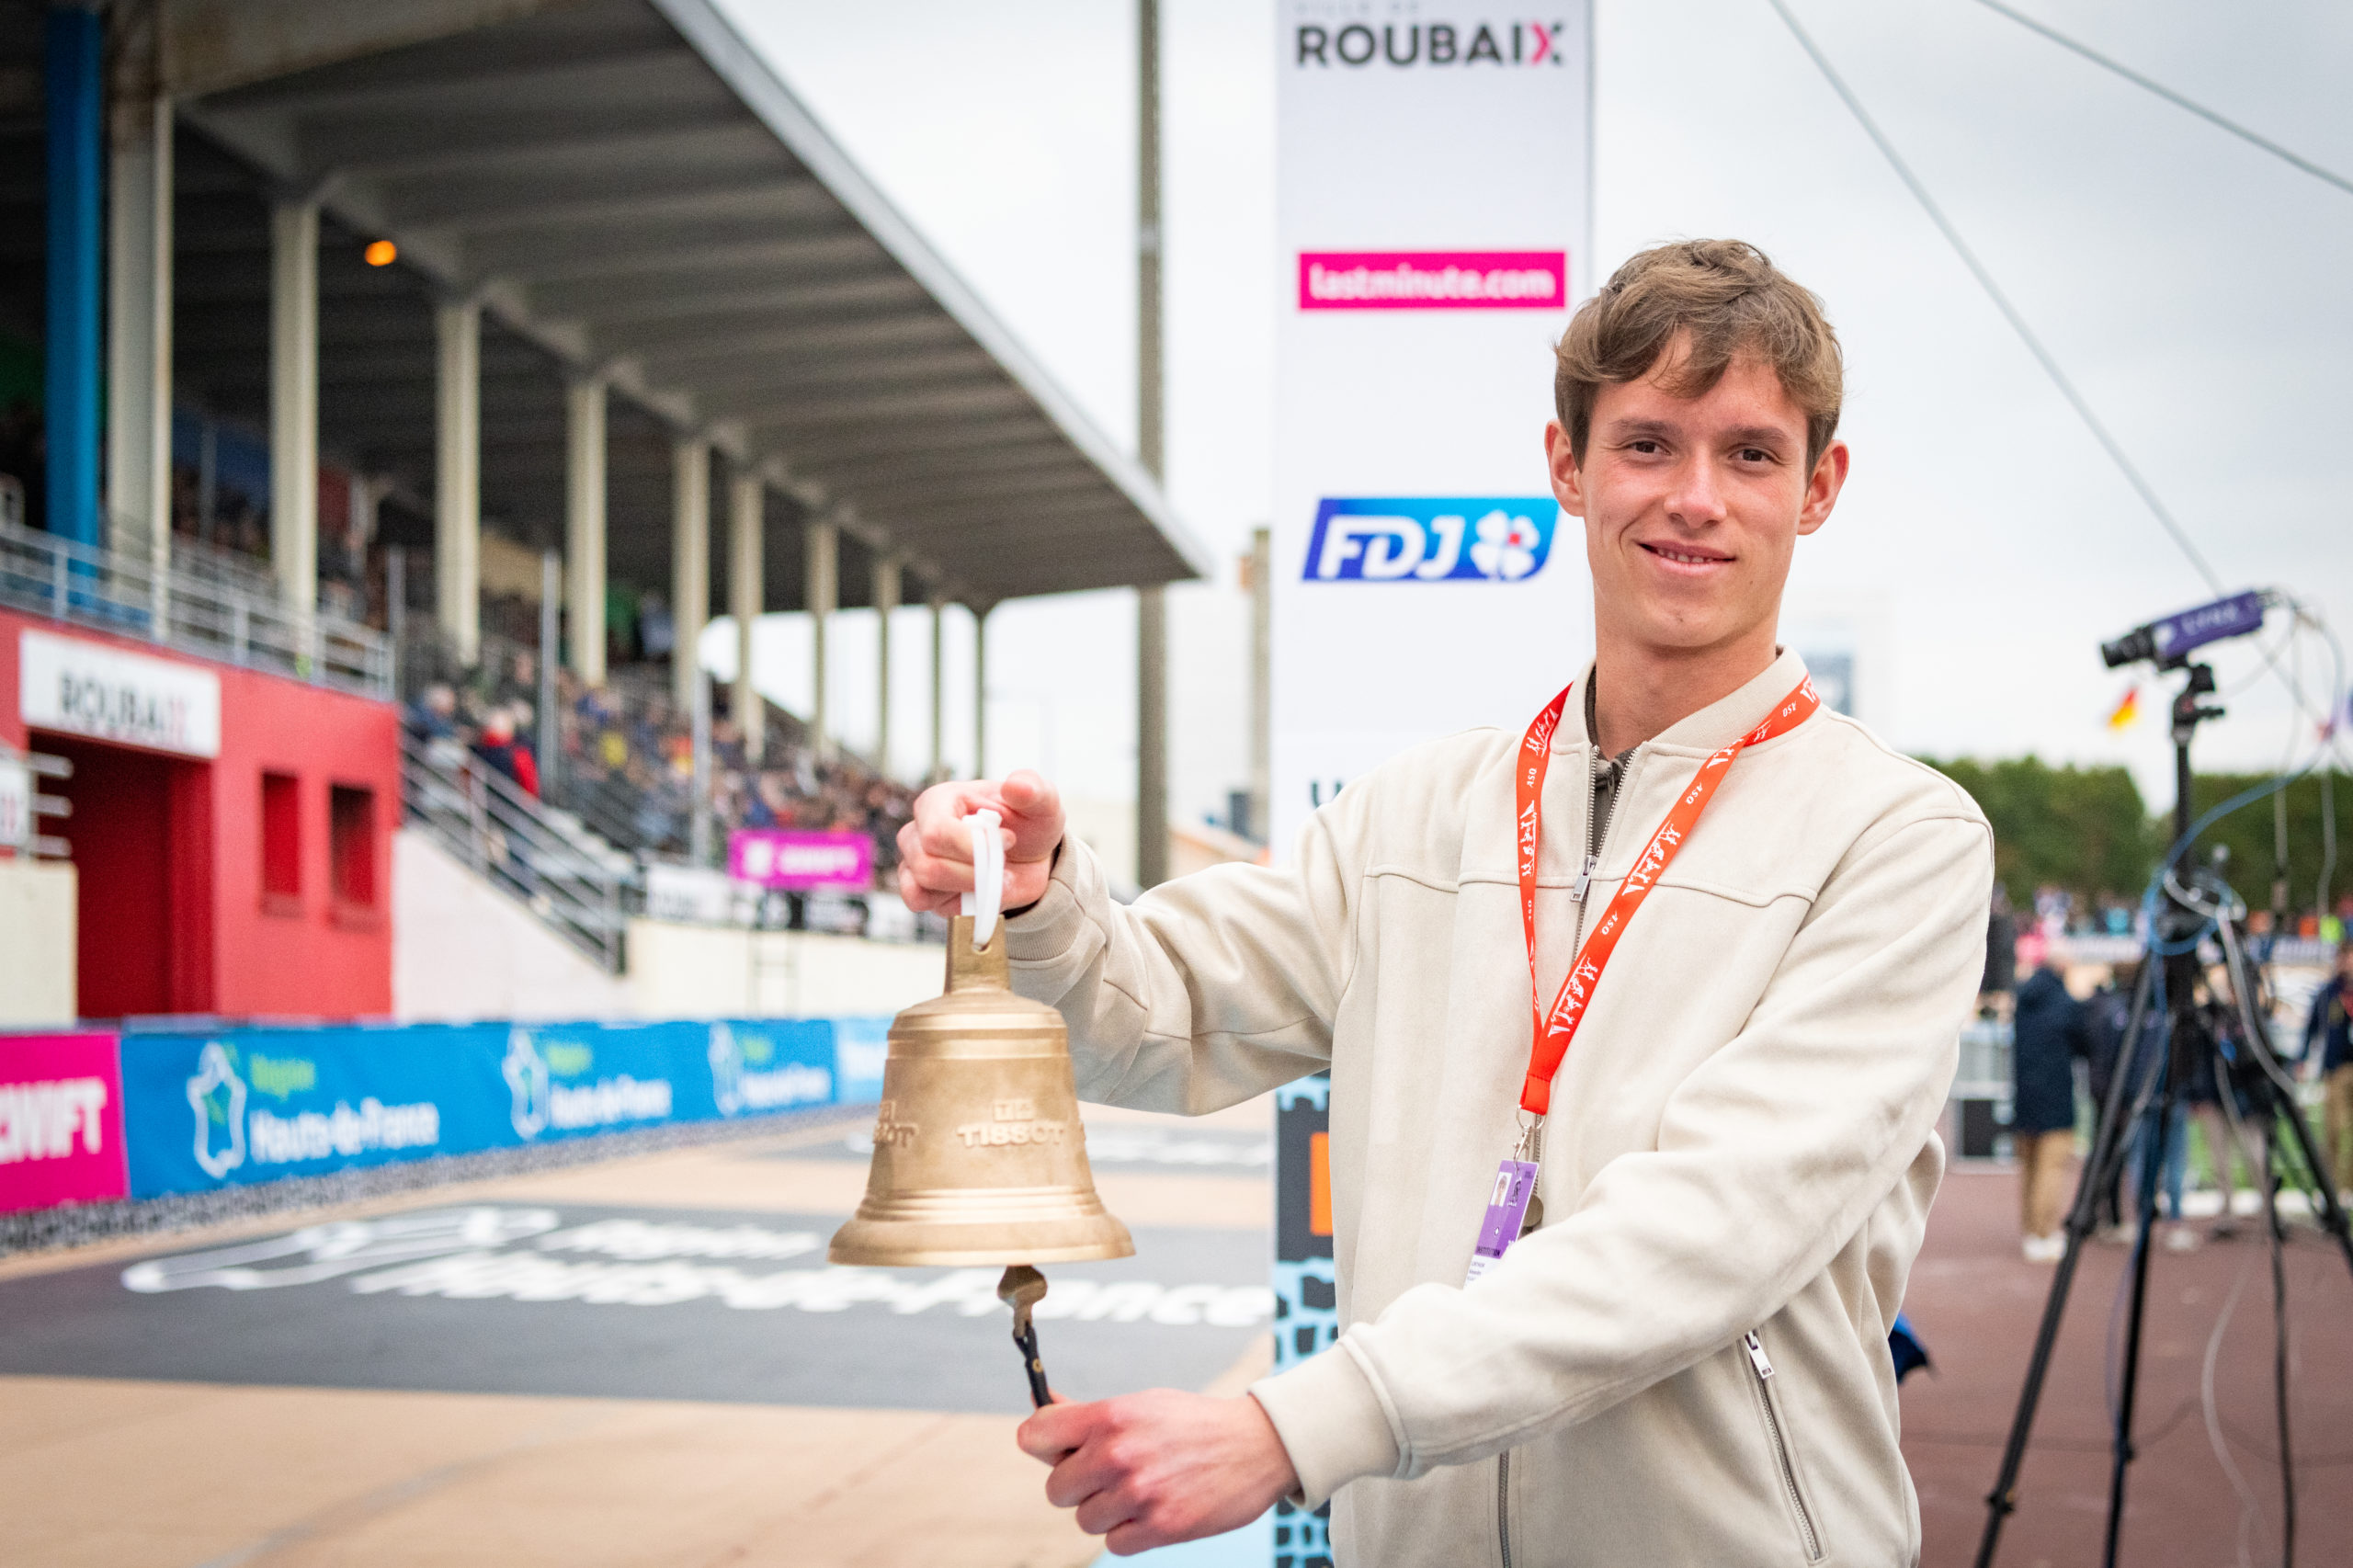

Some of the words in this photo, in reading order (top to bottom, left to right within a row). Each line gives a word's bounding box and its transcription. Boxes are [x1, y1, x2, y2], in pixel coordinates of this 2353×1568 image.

[1296, 24, 1563, 65] ROUBAIX
[1308, 261, 1557, 301] lastminute.com
[1317, 515, 1466, 579] FDJ
[1781, 700, 1797, 718] ASO
[1526, 767, 1538, 789] ASO
[1686, 781, 1703, 805] ASO
[1600, 910, 1620, 936] ASO
[957, 1122, 1067, 1148] TISSOT
